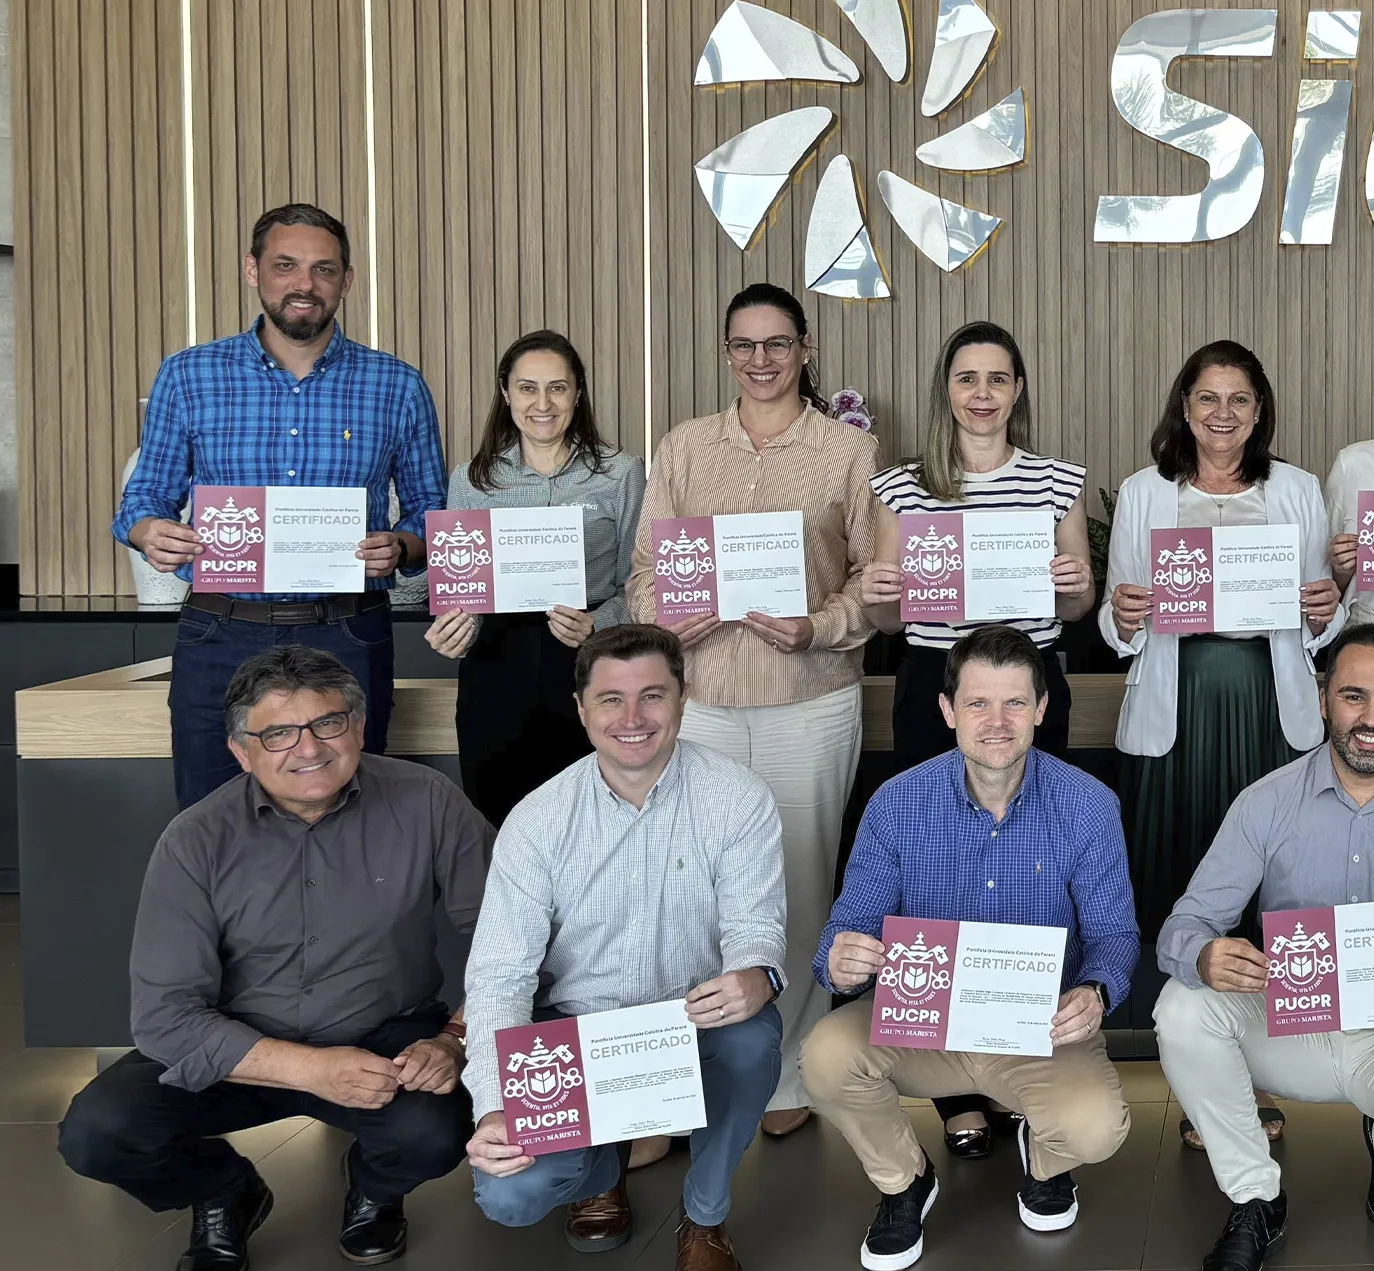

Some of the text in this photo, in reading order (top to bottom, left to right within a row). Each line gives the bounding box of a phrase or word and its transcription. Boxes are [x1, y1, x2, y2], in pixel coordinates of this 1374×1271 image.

[272, 514, 360, 525] CERTIFICADO
[498, 534, 578, 545] CERTIFICADO
[721, 539, 799, 552] CERTIFICADO
[970, 539, 1049, 550] CERTIFICADO
[1218, 552, 1294, 563] CERTIFICADO
[202, 560, 257, 571] PUCPR
[436, 582, 486, 594] PUCPR
[908, 588, 957, 600] PUCPR
[663, 590, 710, 603] PUCPR
[1160, 601, 1206, 613] PUCPR
[962, 956, 1056, 973] CERTIFICADO
[1276, 994, 1331, 1011] PUCPR
[882, 1007, 940, 1024] PUCPR
[589, 1032, 691, 1060] CERTIFICADO
[516, 1109, 579, 1132] PUCPR
[519, 1130, 581, 1145] GRUPO MARISTA
